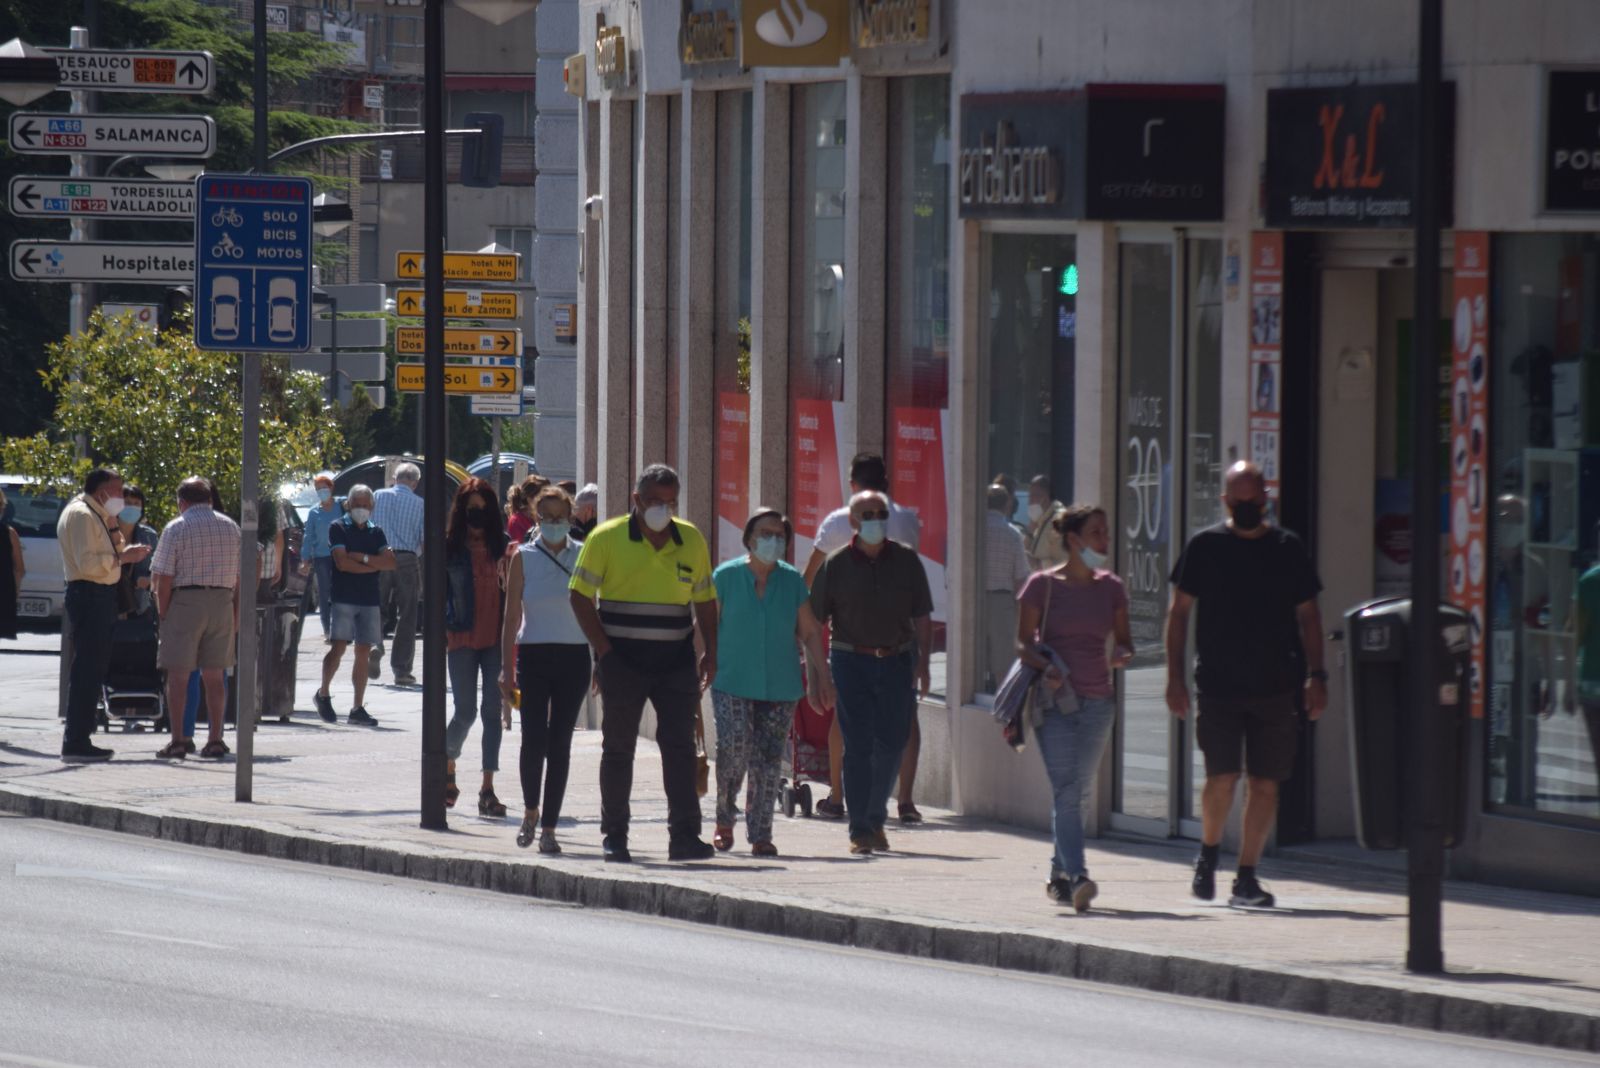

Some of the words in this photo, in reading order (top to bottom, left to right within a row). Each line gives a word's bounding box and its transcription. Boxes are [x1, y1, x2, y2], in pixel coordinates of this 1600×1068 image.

[57, 56, 131, 69] TESAUCO
[58, 70, 117, 83] OSELLE
[51, 121, 81, 132] A-66
[44, 134, 86, 146] N-630
[95, 128, 204, 143] SALAMANCA
[62, 185, 91, 196] E-82
[111, 186, 194, 198] TORDESILLA
[45, 199, 68, 211] A-11
[72, 200, 107, 212] N-122
[110, 200, 195, 213] VALLADOLI
[263, 211, 298, 222] SOLO
[263, 229, 297, 241] BICIS
[257, 247, 303, 259] MOTOS
[102, 255, 195, 273] Hospitales
[471, 259, 493, 267] hotel
[497, 259, 512, 267] NH
[443, 267, 469, 276] alacio
[486, 269, 512, 278] Duero
[462, 304, 473, 314] de
[477, 304, 512, 315] Zamora
[401, 331, 424, 339] hotel
[401, 340, 422, 349] Dos
[444, 341, 476, 351] antas
[401, 375, 425, 384] host
[444, 373, 468, 384] Sol
[1127, 436, 1162, 540] 30
